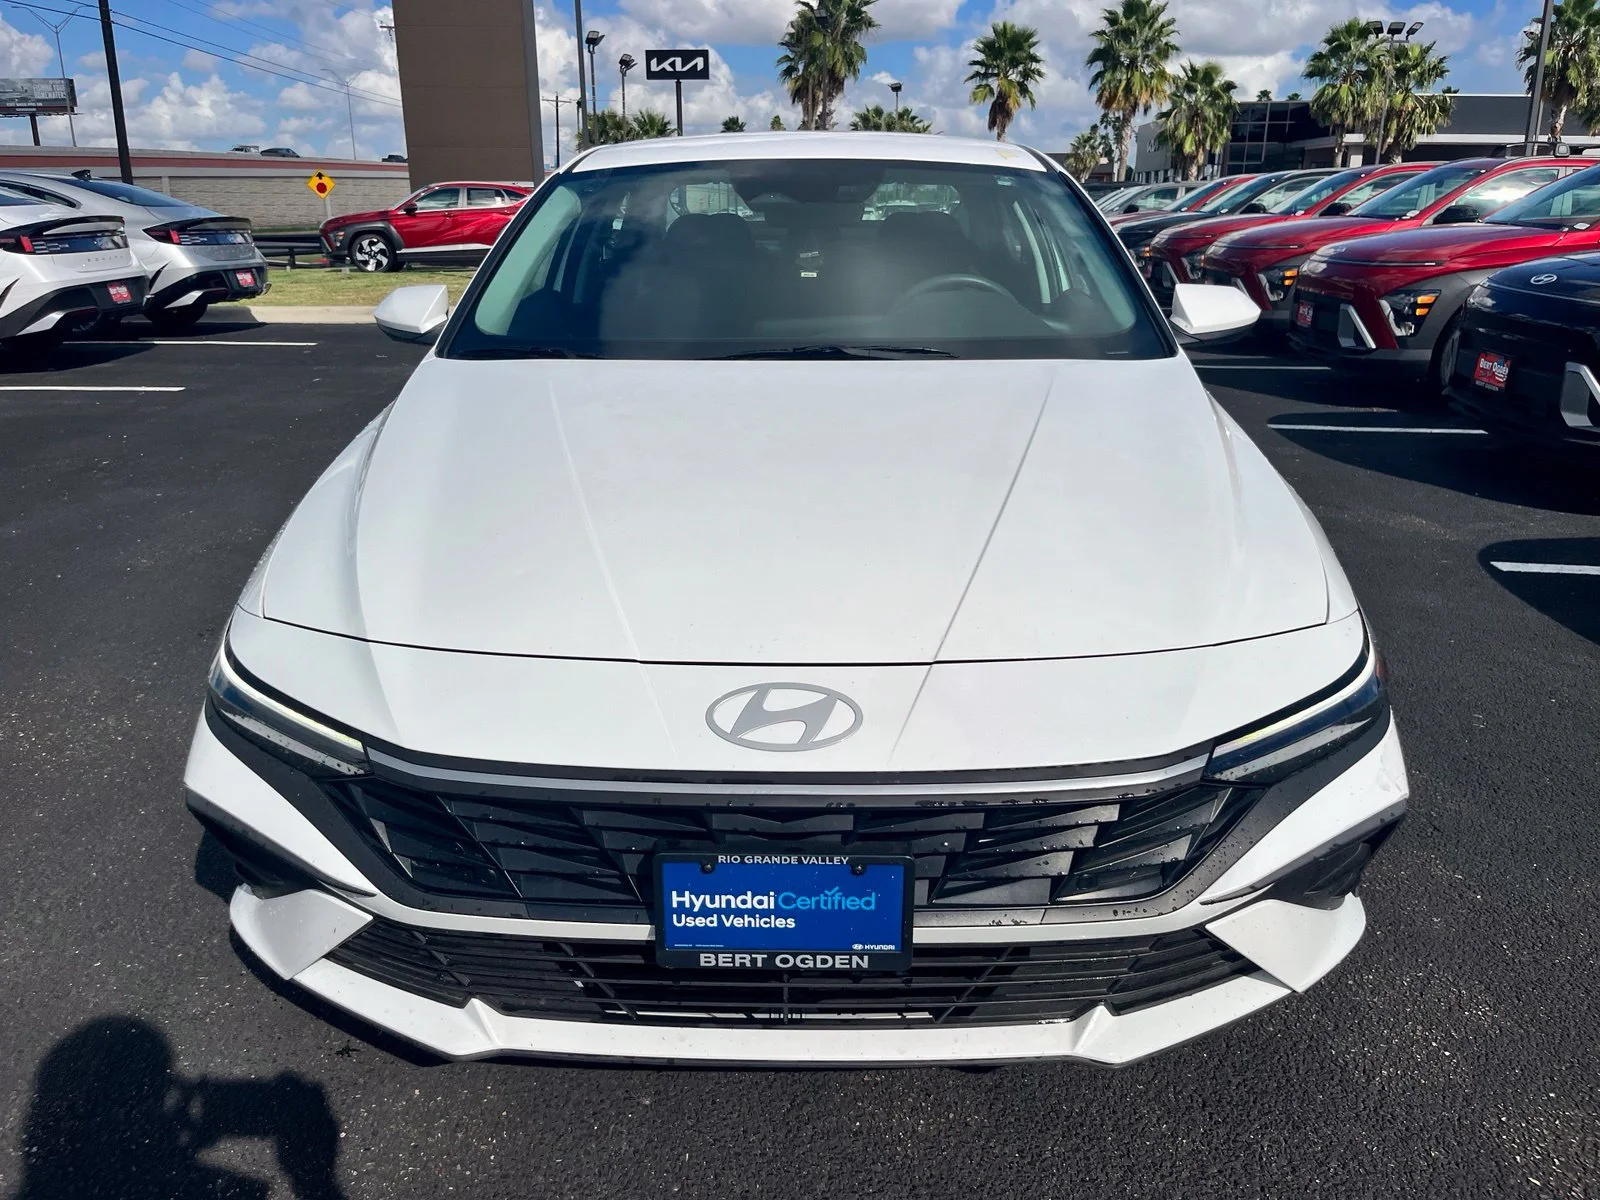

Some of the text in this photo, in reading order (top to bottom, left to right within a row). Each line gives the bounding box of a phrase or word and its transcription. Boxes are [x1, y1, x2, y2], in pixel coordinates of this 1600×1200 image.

[650, 57, 704, 72] KIA
[717, 855, 849, 865] RIO GRANDE VALLEY
[671, 887, 876, 912] Hyundai Certified
[672, 914, 796, 928] Used Vehicles
[700, 954, 869, 969] BERT OGDEN
